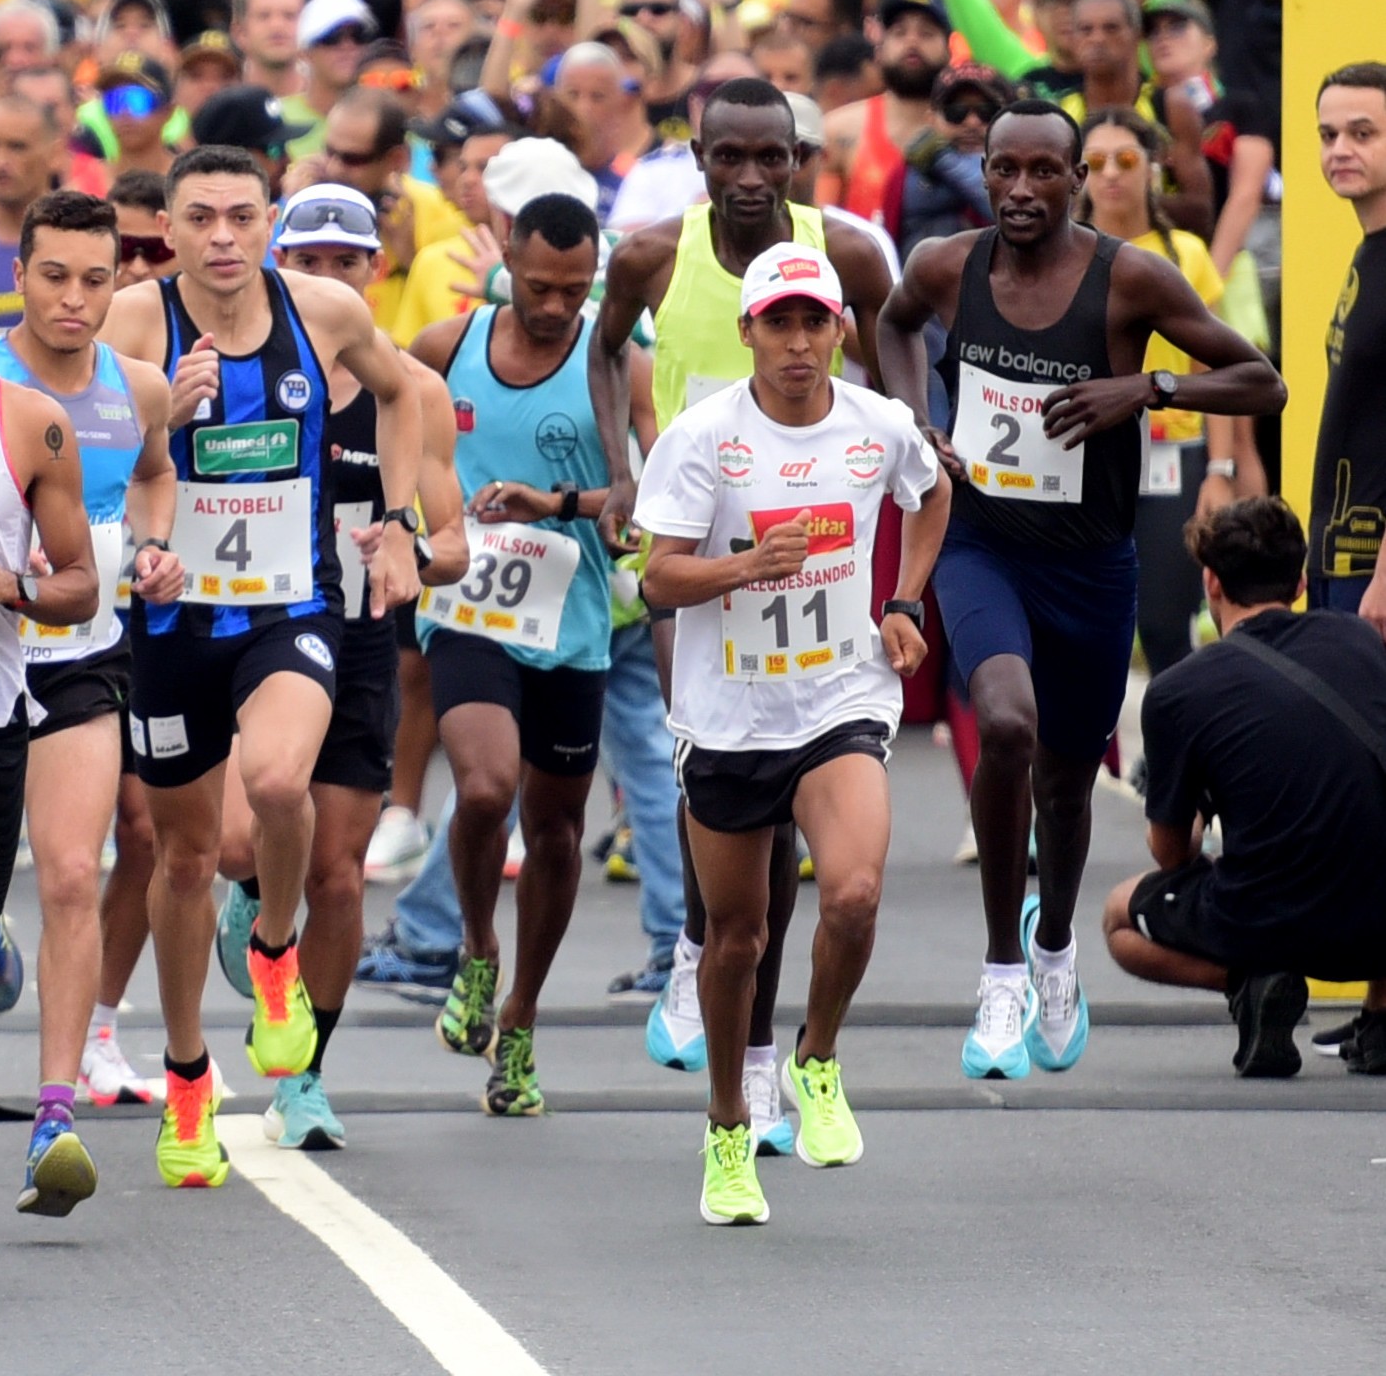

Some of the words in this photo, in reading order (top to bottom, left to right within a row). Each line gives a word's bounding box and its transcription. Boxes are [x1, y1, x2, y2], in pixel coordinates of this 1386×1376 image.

[998, 345, 1092, 381] balance
[982, 385, 1044, 415] WILSON
[205, 434, 266, 451] Unimed
[985, 412, 1022, 468] 2
[194, 496, 284, 514] ALTOBELI
[215, 518, 252, 572] 4
[483, 531, 548, 559] WILSON
[460, 553, 532, 608] 39
[761, 589, 829, 648] 11
